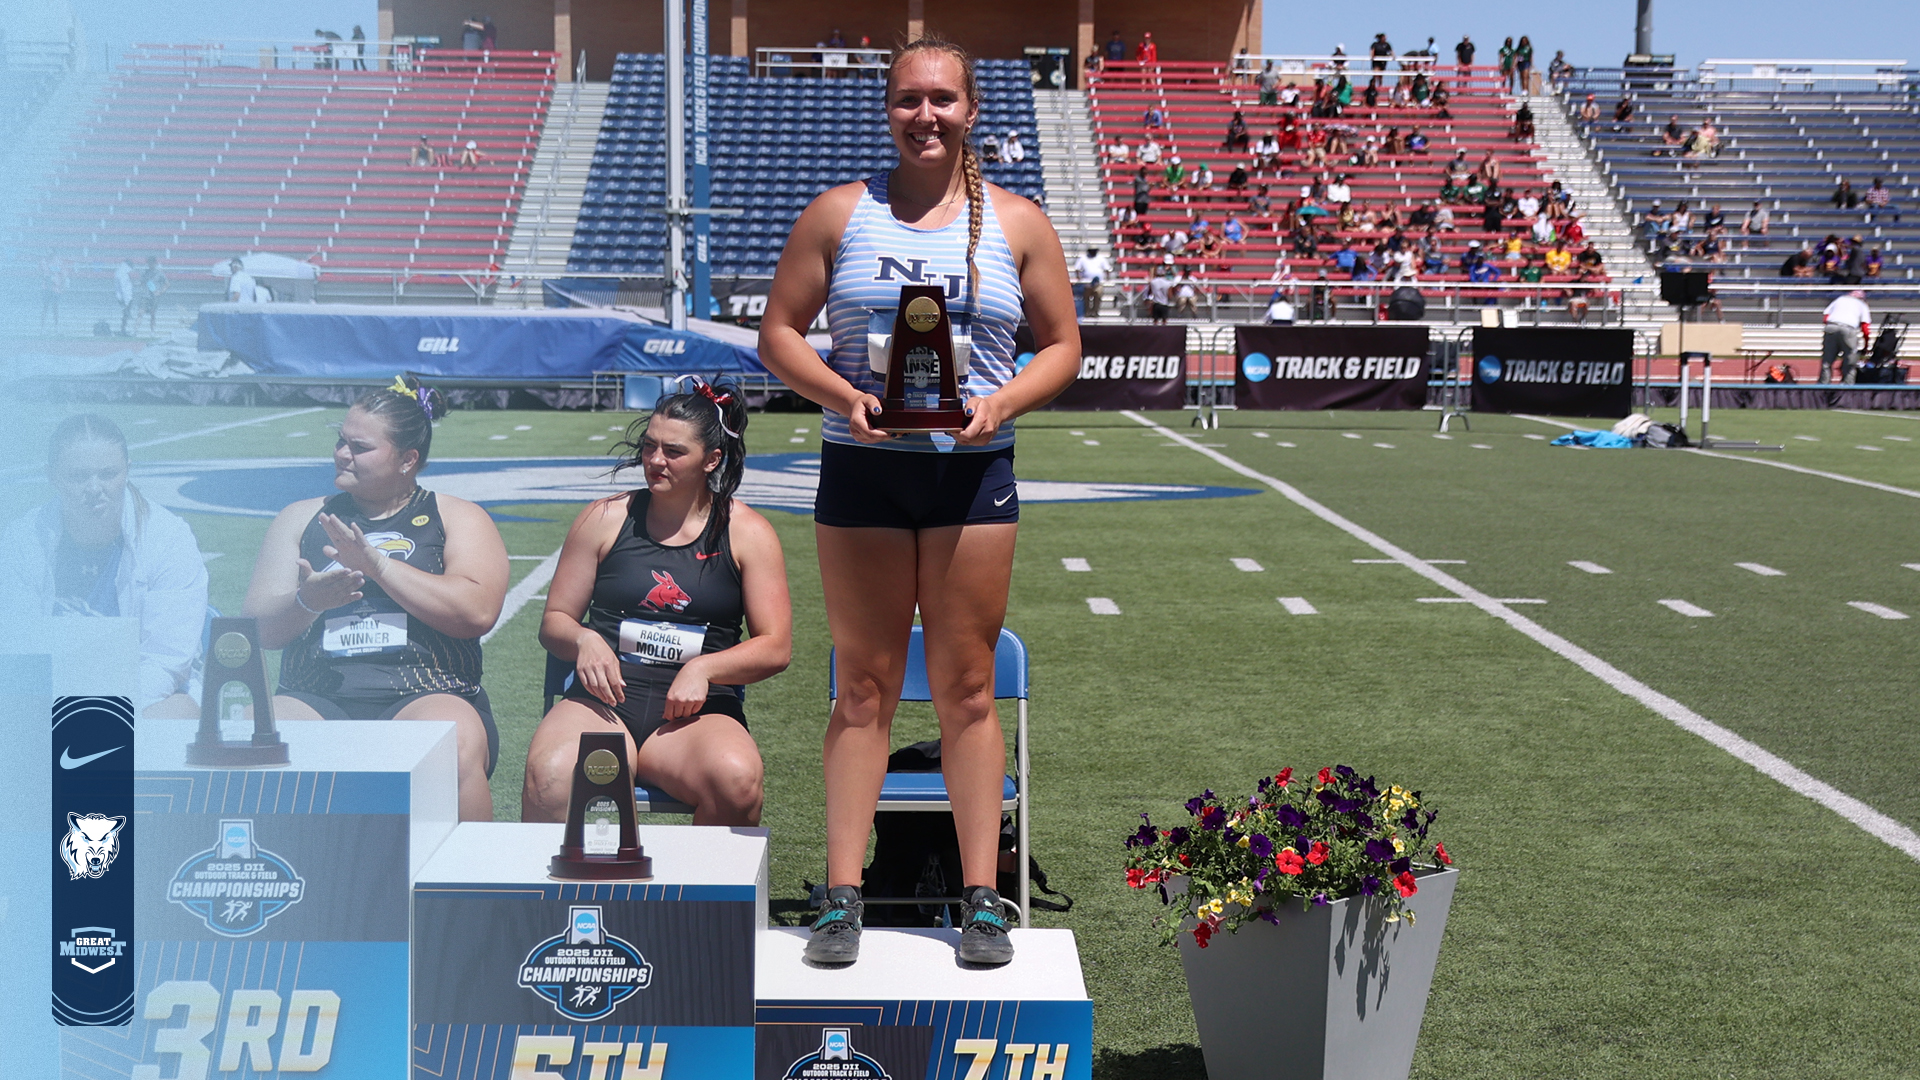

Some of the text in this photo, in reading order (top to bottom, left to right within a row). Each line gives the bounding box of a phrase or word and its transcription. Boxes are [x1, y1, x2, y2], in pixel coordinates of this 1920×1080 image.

[694, 57, 706, 87] FIELD
[694, 87, 707, 97] &
[695, 98, 707, 133] TRACK
[695, 136, 707, 165] NCAA
[697, 234, 708, 263] GILL
[417, 337, 459, 352] GILL
[643, 339, 686, 354] GILL
[1109, 356, 1126, 379] &
[1126, 356, 1180, 379] FIELD
[1275, 356, 1344, 379] TRACK
[1344, 356, 1362, 380] &
[1362, 356, 1421, 379] FIELD
[1504, 359, 1560, 382] TRACK
[1560, 361, 1576, 384] &
[1575, 361, 1626, 385] FIELD
[350, 619, 380, 630] MOLLY
[340, 632, 390, 647] WINNER
[640, 630, 682, 646] RACHAEL
[636, 641, 683, 661] MOLLOY
[586, 765, 617, 776] NCAA
[207, 863, 265, 871] 2025 DII
[195, 871, 277, 880] OUTDOOR TRACK & FIELD
[172, 882, 300, 898] CHAMPIONSHIPS
[814, 909, 848, 929] NIKE
[972, 910, 1005, 928] NIKE
[545, 956, 626, 965] OUTDOOR TRACK & FIELD
[557, 949, 613, 957] 2025 DII
[523, 967, 648, 983] CHAMPIONSHIPS
[131, 981, 341, 1080] 3RD
[954, 1039, 1069, 1080] 7TH
